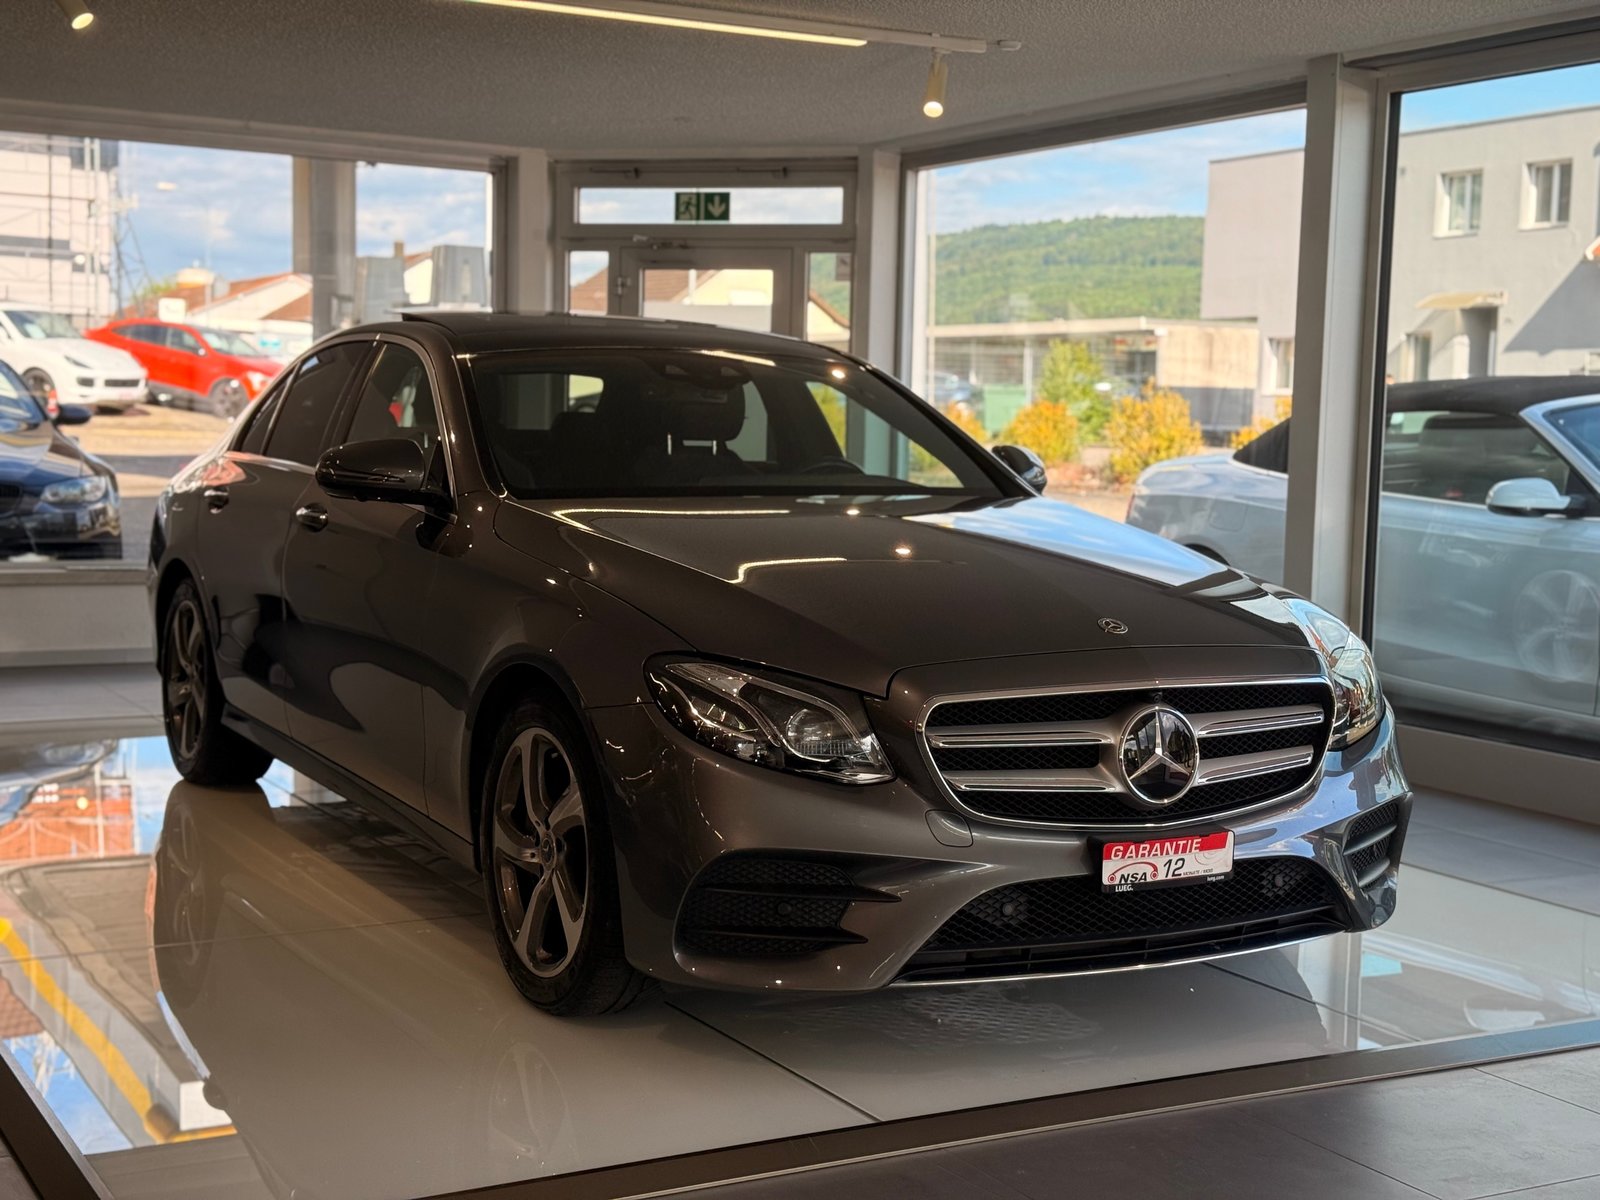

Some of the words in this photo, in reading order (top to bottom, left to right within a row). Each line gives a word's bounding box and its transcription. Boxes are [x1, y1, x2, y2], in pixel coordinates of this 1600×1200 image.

[1111, 838, 1202, 860] GARANTIE
[1119, 872, 1147, 884] NSA
[1163, 857, 1185, 878] 12
